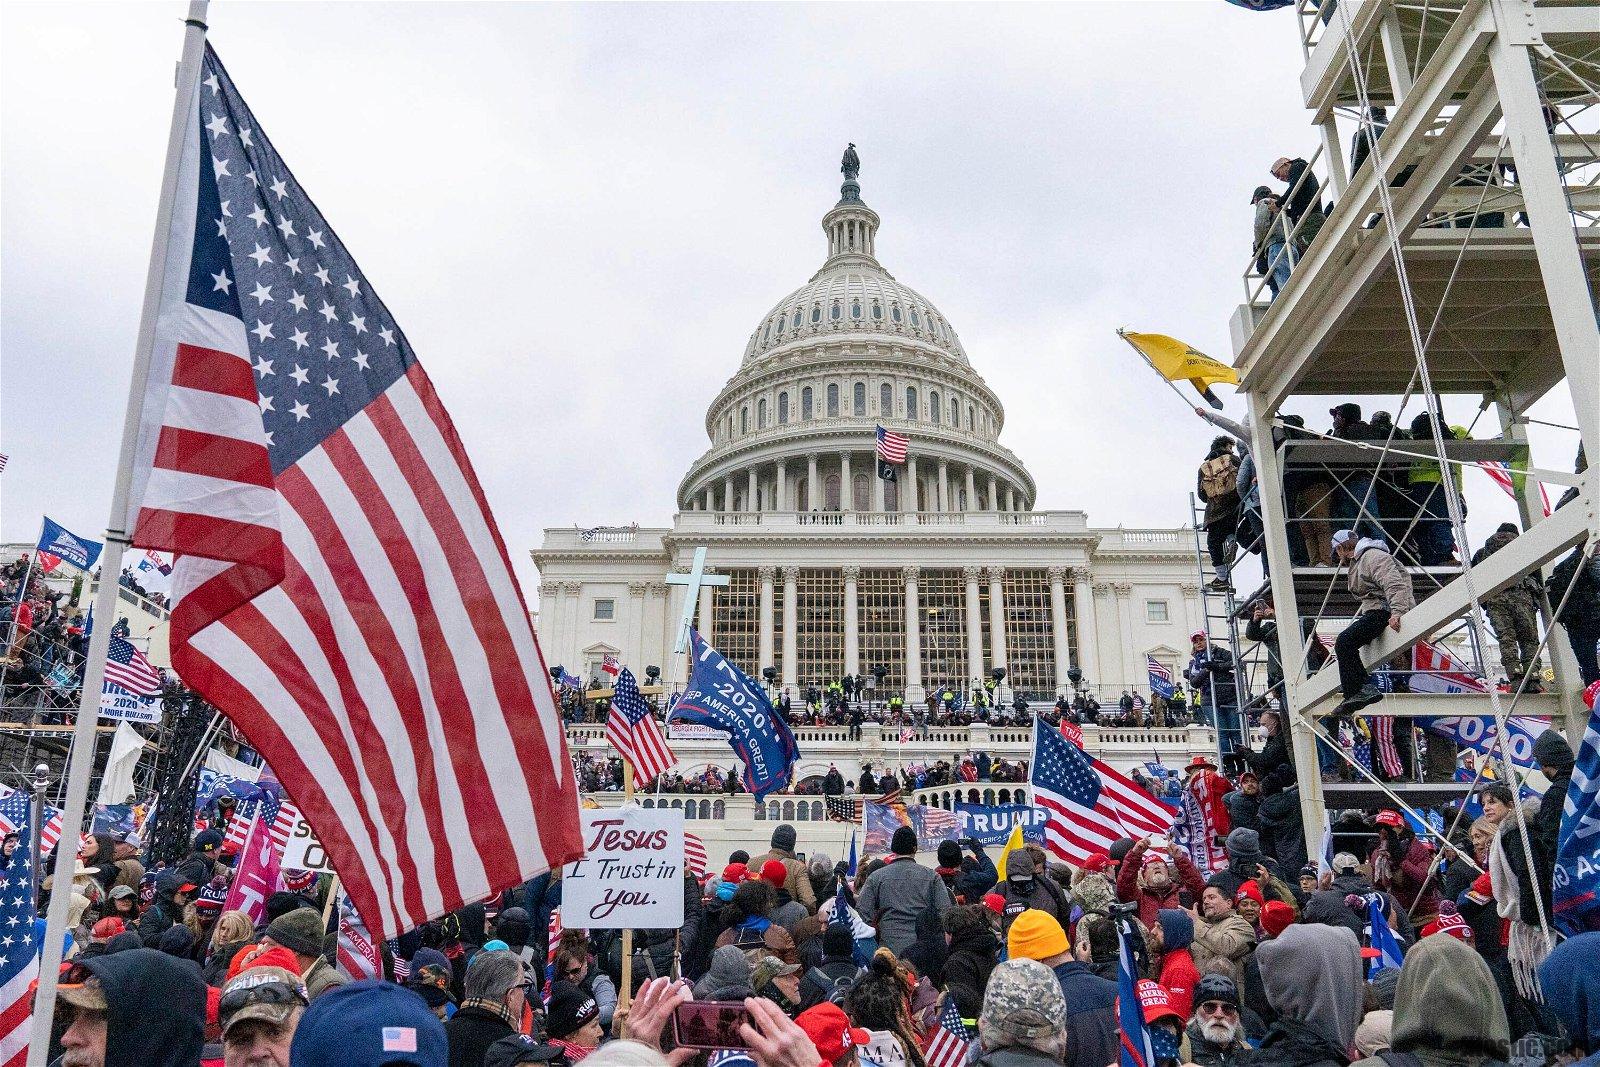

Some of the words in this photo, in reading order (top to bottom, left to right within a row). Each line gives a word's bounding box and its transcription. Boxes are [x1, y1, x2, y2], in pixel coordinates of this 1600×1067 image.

[113, 698, 138, 709] 2020
[104, 708, 124, 717] MORE
[702, 695, 749, 739] AMERICA
[749, 738, 769, 781] GREAT!
[1431, 716, 1532, 760] 2020
[957, 809, 1047, 832] TRUMP
[588, 819, 668, 852] Jesus
[978, 834, 1001, 844] MERICA
[566, 859, 590, 878] I
[598, 858, 655, 879] Trust
[656, 861, 676, 878] in
[200, 886, 229, 900] TRUM
[589, 888, 657, 920] you.
[1006, 907, 1025, 915] TRUMP
[1141, 997, 1168, 1007] GREAT
